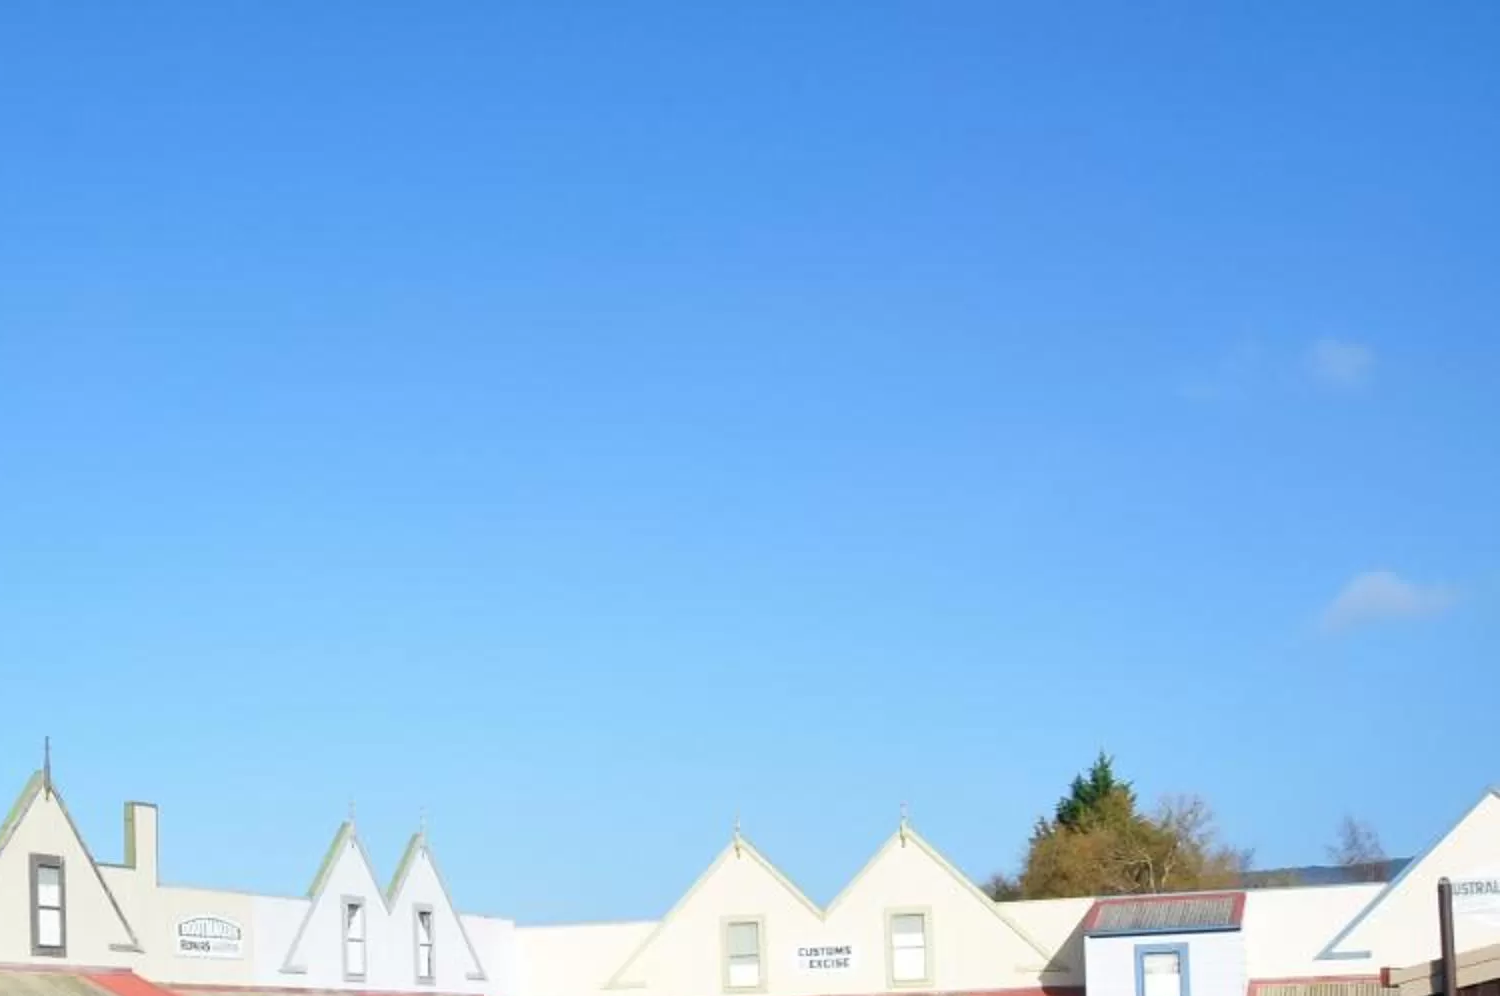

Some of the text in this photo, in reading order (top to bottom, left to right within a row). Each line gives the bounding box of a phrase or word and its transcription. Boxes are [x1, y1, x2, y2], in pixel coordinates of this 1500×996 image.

[1452, 880, 1500, 895] USTRAL
[797, 946, 852, 957] CUSTOMS
[809, 957, 850, 969] EXCISE
